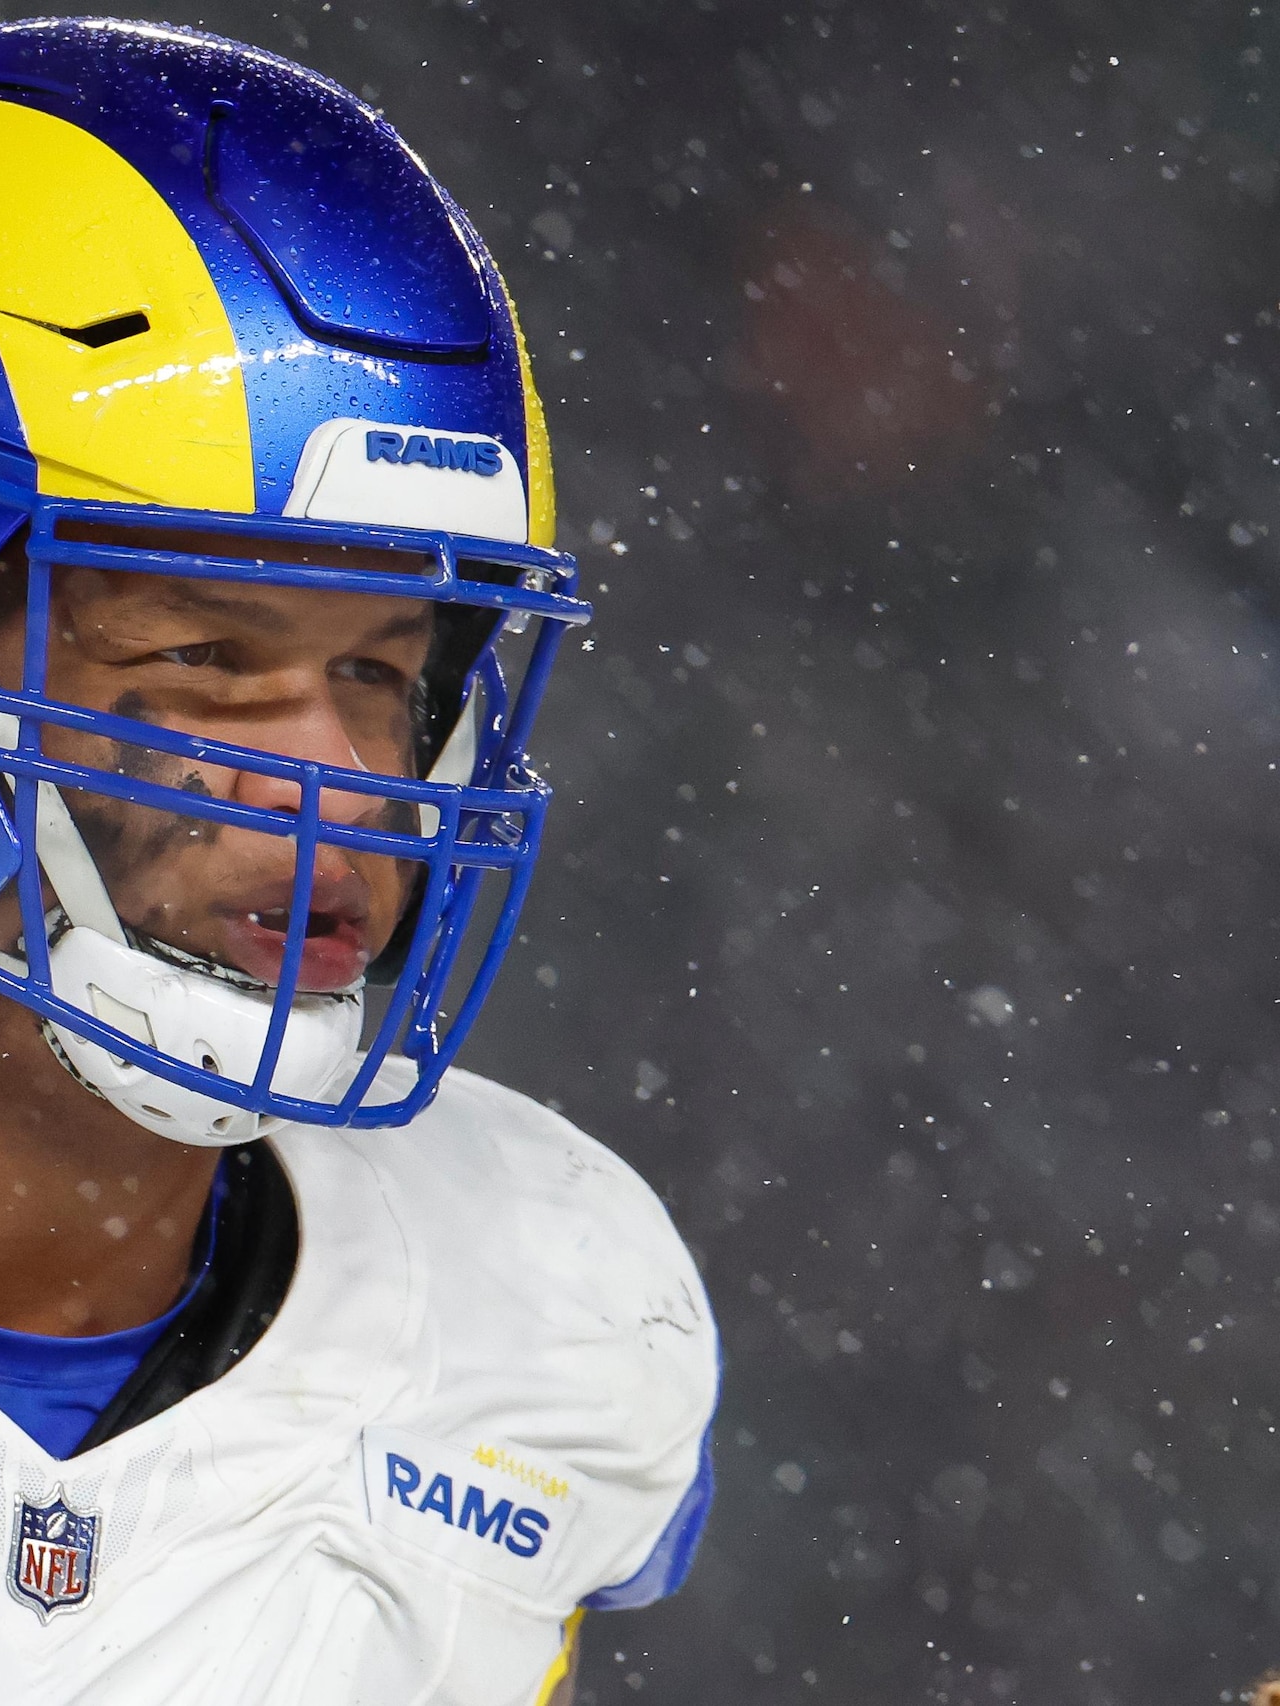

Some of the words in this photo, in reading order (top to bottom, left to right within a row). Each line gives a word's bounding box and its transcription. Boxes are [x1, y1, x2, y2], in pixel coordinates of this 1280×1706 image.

[366, 430, 503, 477] RAMS
[386, 1452, 550, 1558] RAMS
[22, 1543, 82, 1597] NFL
